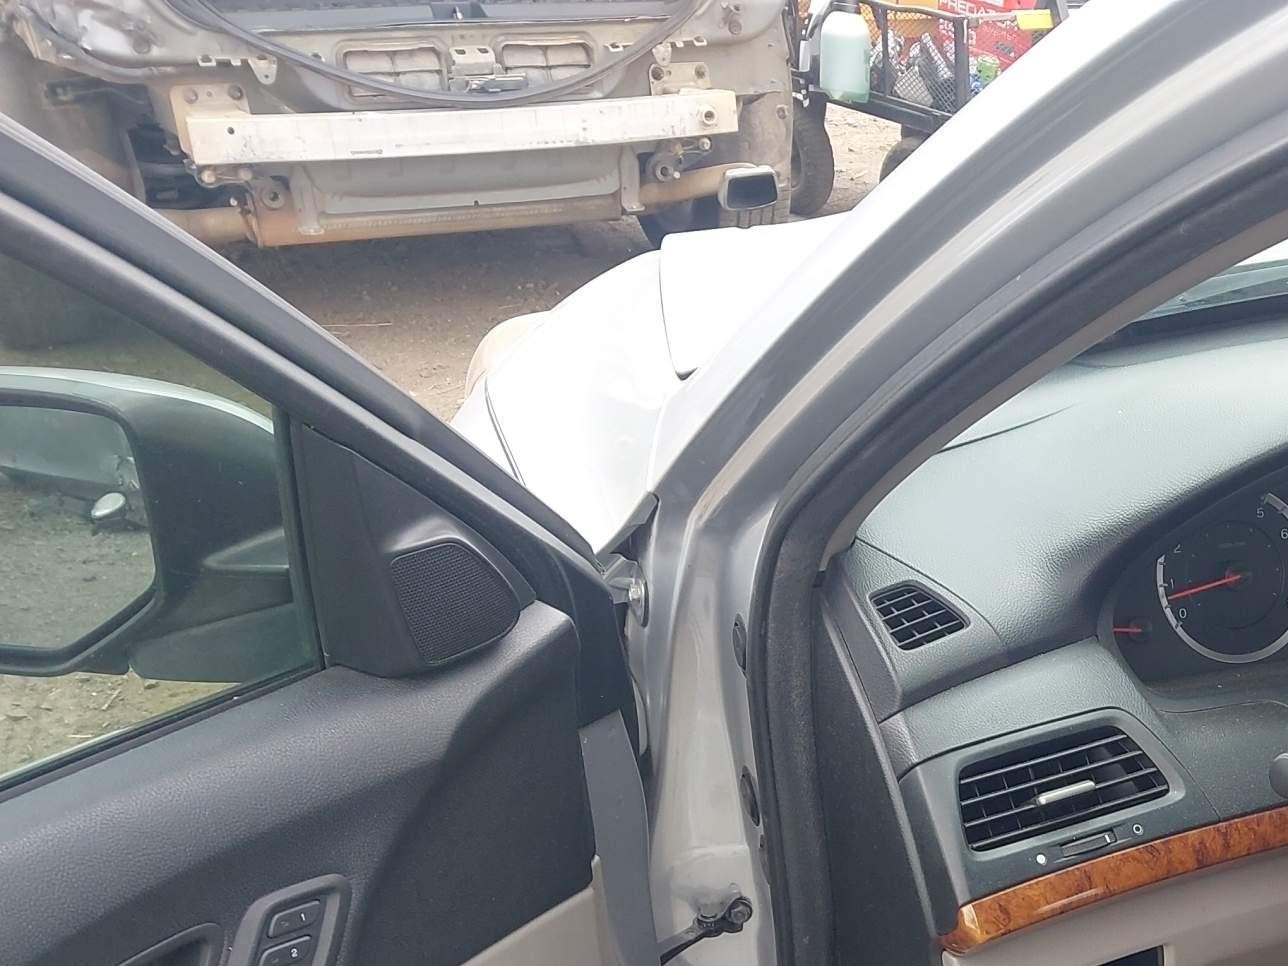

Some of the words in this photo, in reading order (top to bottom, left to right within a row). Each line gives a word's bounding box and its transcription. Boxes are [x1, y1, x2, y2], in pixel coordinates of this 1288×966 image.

[1256, 507, 1264, 519] 5
[1280, 528, 1288, 540] 6
[1178, 607, 1188, 619] 0
[300, 913, 306, 921] 1
[290, 948, 298, 958] 2
